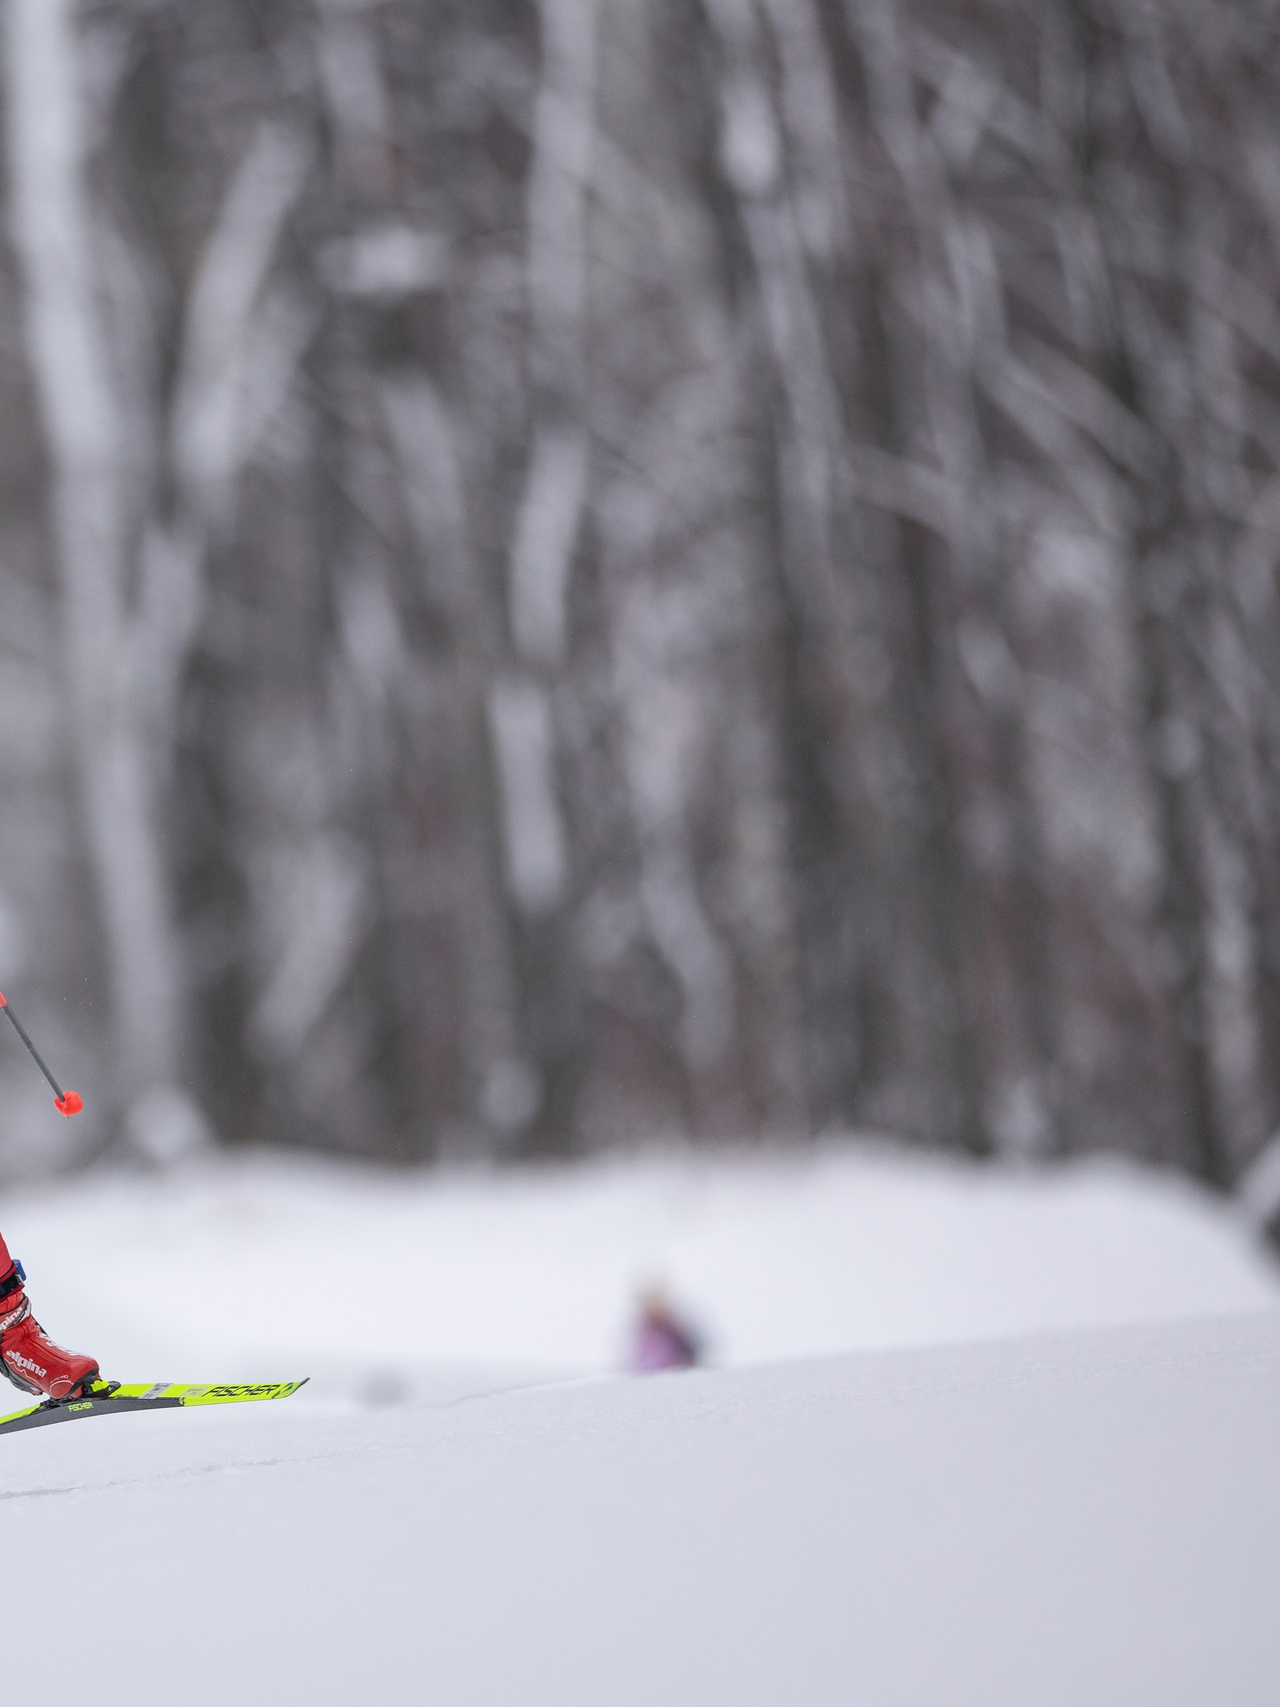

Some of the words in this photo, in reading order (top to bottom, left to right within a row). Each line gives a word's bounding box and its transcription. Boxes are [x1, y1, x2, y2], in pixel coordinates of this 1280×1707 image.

[6, 1349, 48, 1378] alpina
[202, 1384, 281, 1397] FISCHER
[68, 1401, 94, 1412] FISCHER
